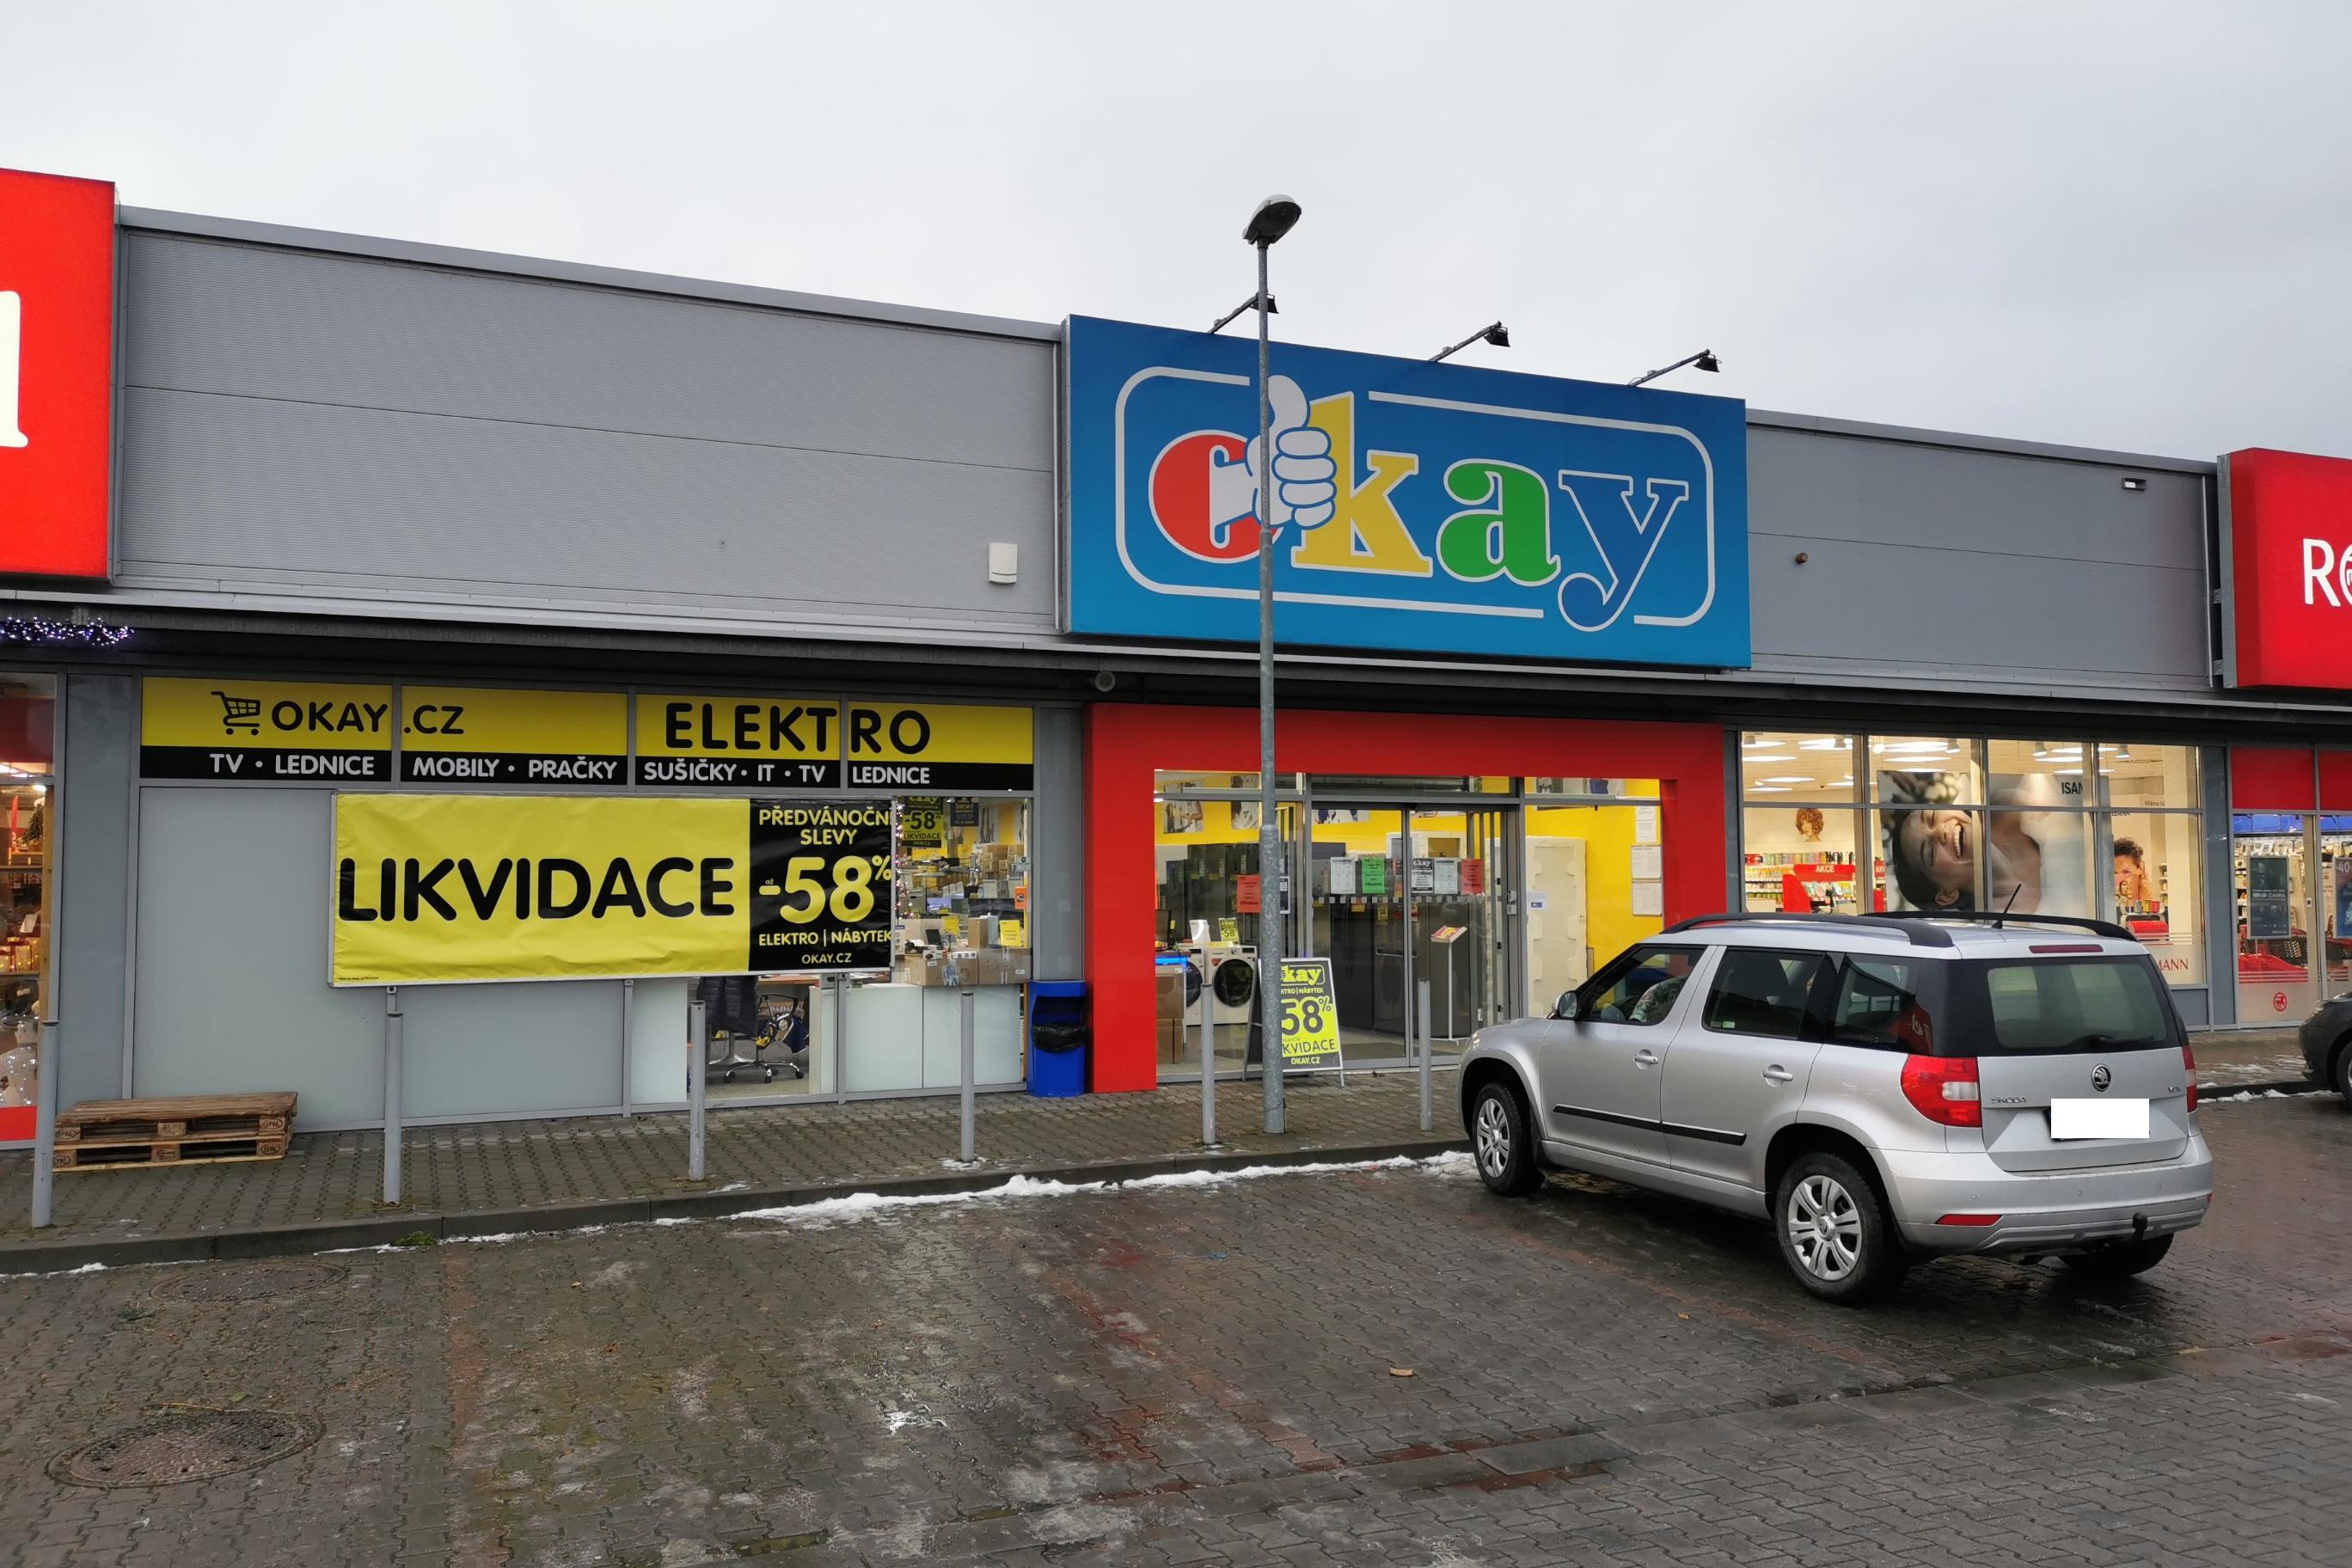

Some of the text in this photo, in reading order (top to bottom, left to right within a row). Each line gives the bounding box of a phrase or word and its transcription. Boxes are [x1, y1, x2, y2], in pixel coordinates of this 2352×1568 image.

[666, 702, 930, 755] ELEKTRO
[210, 753, 930, 784] TV LEDNICE MOBILY PRAČKY SUŠIČKY IT TV LEDNICE
[759, 805, 891, 825] PŘEDVÁNOČN
[800, 829, 857, 846] SLEVY
[339, 857, 735, 922] LIKVIDACE
[759, 928, 891, 946] ELEKTRO NÁBYTEK
[801, 952, 852, 964] OKAY.CZ
[1281, 965, 1321, 985] kay
[1282, 1038, 1336, 1055] KVIDACE
[1290, 1057, 1320, 1065] OKAY.CZ
